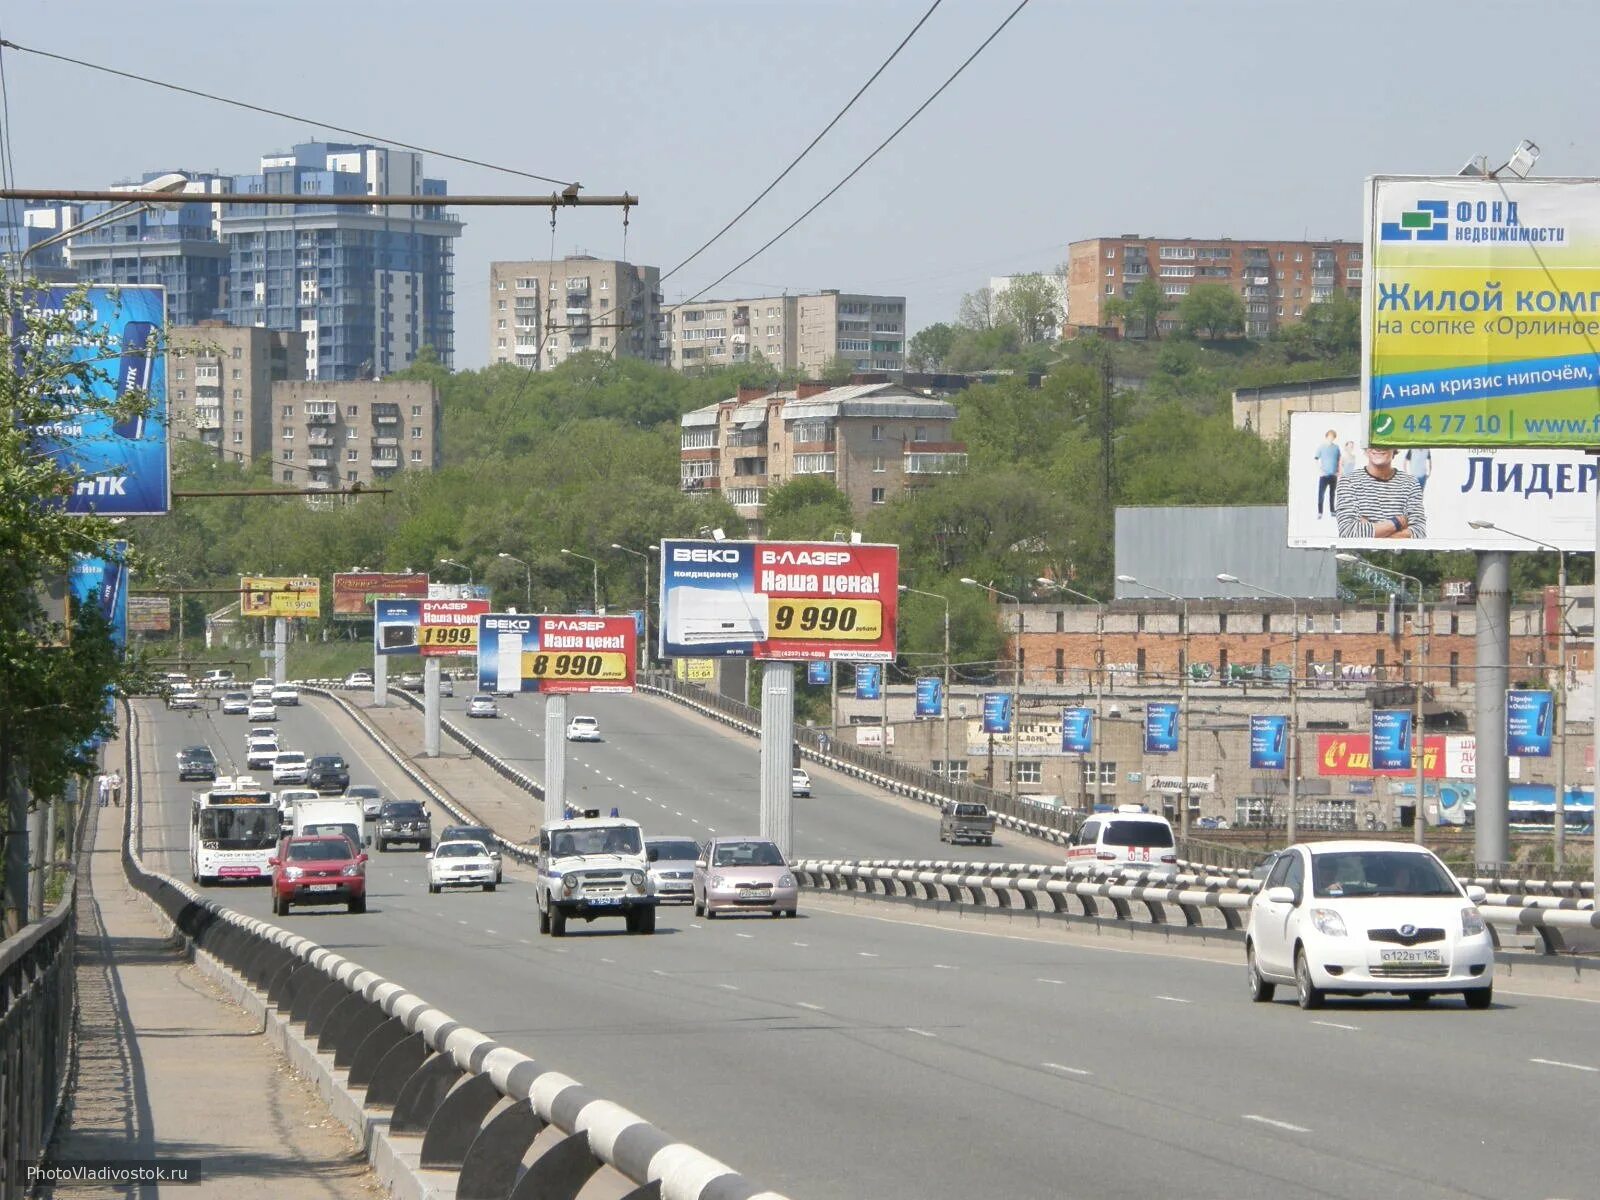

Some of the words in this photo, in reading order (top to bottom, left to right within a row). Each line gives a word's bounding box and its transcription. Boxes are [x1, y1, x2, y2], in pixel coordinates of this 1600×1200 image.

[1455, 201, 1519, 226] ФОНД
[1377, 281, 1503, 312] Жилой
[1377, 319, 1402, 334] на
[1410, 318, 1475, 335] сопке
[1484, 316, 1600, 339] «Орлиное
[1382, 383, 1395, 399] А
[1399, 381, 1435, 397] нам
[1440, 373, 1502, 398] кризис
[1507, 365, 1593, 386] нипочём,
[1403, 414, 1431, 433] 44
[1440, 414, 1466, 433] 77
[1475, 414, 1500, 433] 10
[77, 476, 127, 496] НТК
[673, 549, 740, 563] BEKO
[761, 570, 819, 592] Наша
[822, 572, 880, 595] цена!
[423, 612, 452, 624] Наша
[485, 619, 530, 629] BEKO
[774, 605, 794, 631] 9
[800, 606, 857, 632] 990
[424, 628, 433, 643] 1
[436, 627, 471, 643] 999
[544, 634, 583, 648] Наша
[585, 635, 624, 650] цена!
[532, 655, 549, 675] 8
[554, 655, 602, 676] 990
